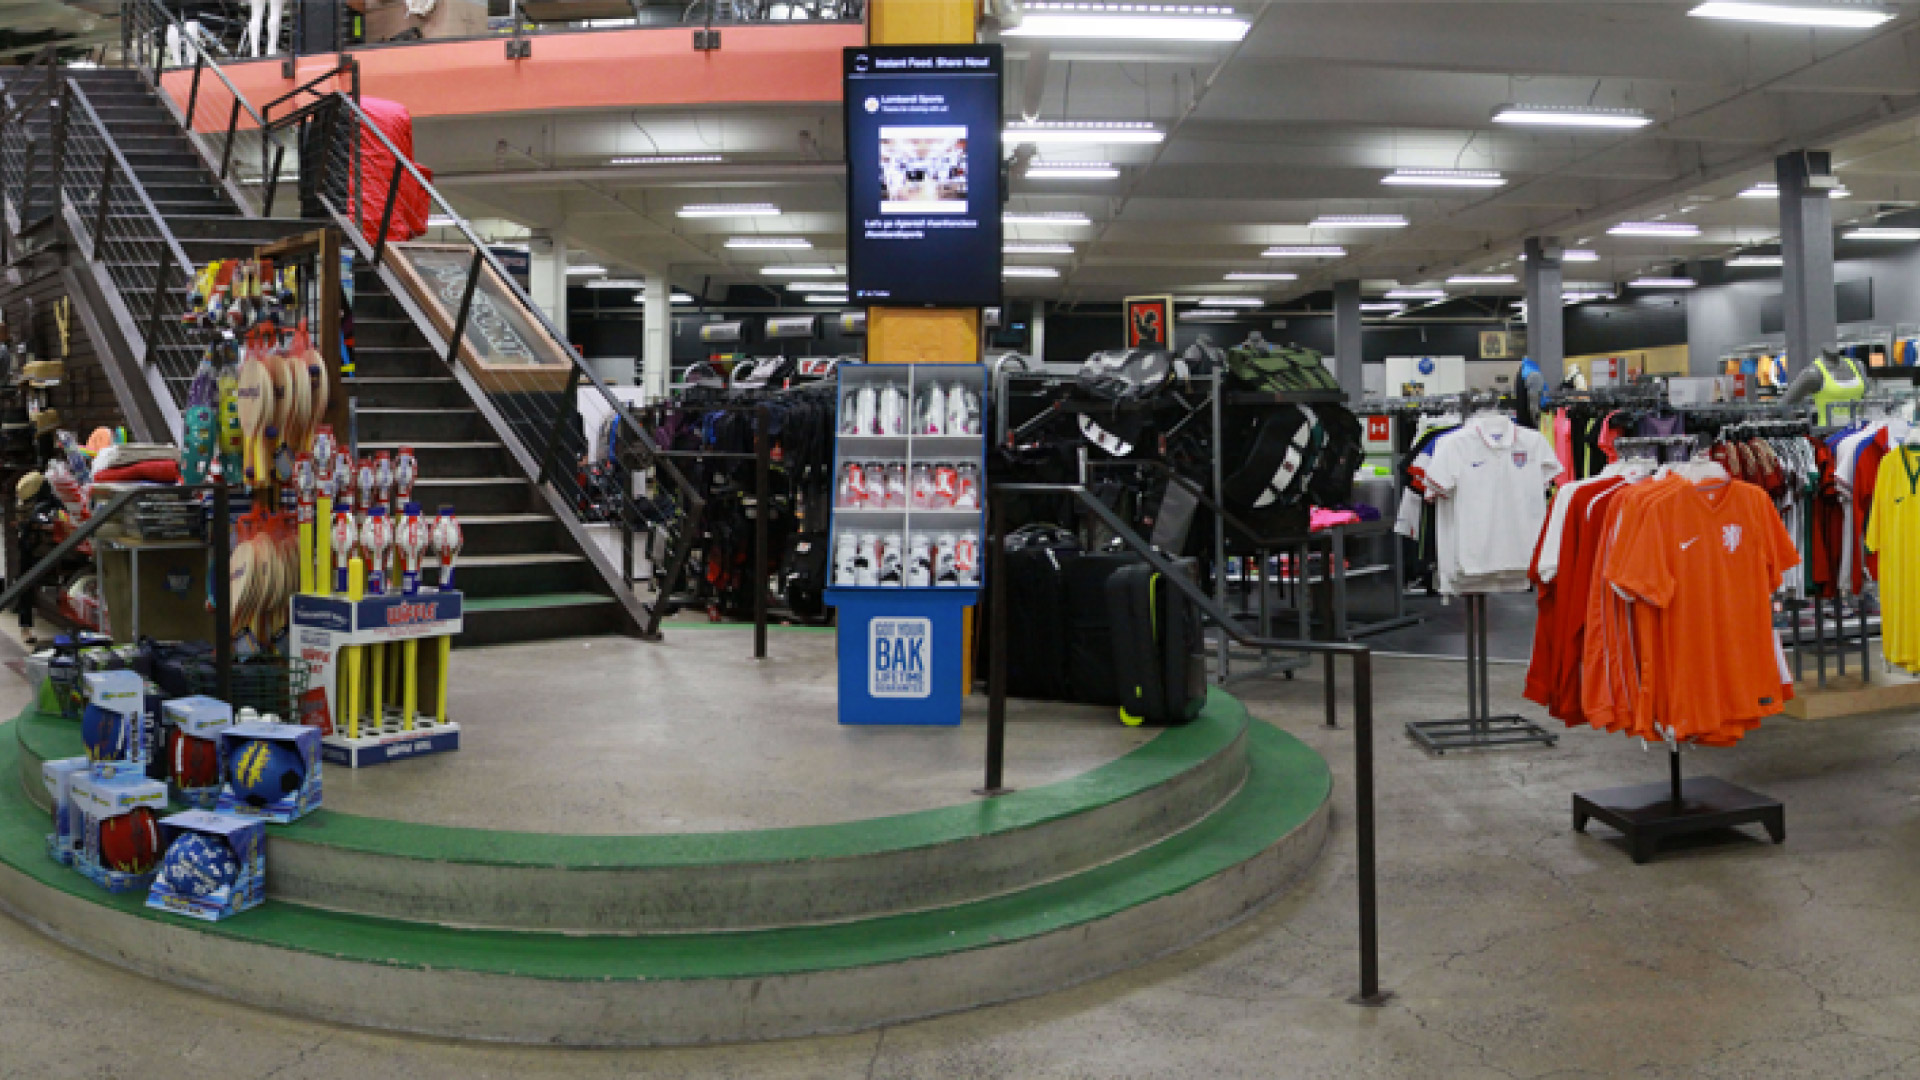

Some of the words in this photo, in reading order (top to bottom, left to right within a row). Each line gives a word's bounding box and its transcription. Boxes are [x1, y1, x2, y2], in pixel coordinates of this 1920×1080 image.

[875, 57, 907, 68] Instant
[935, 56, 964, 68] Share
[965, 56, 991, 68] Now!
[919, 95, 945, 105] Sports
[875, 637, 924, 671] BAK
